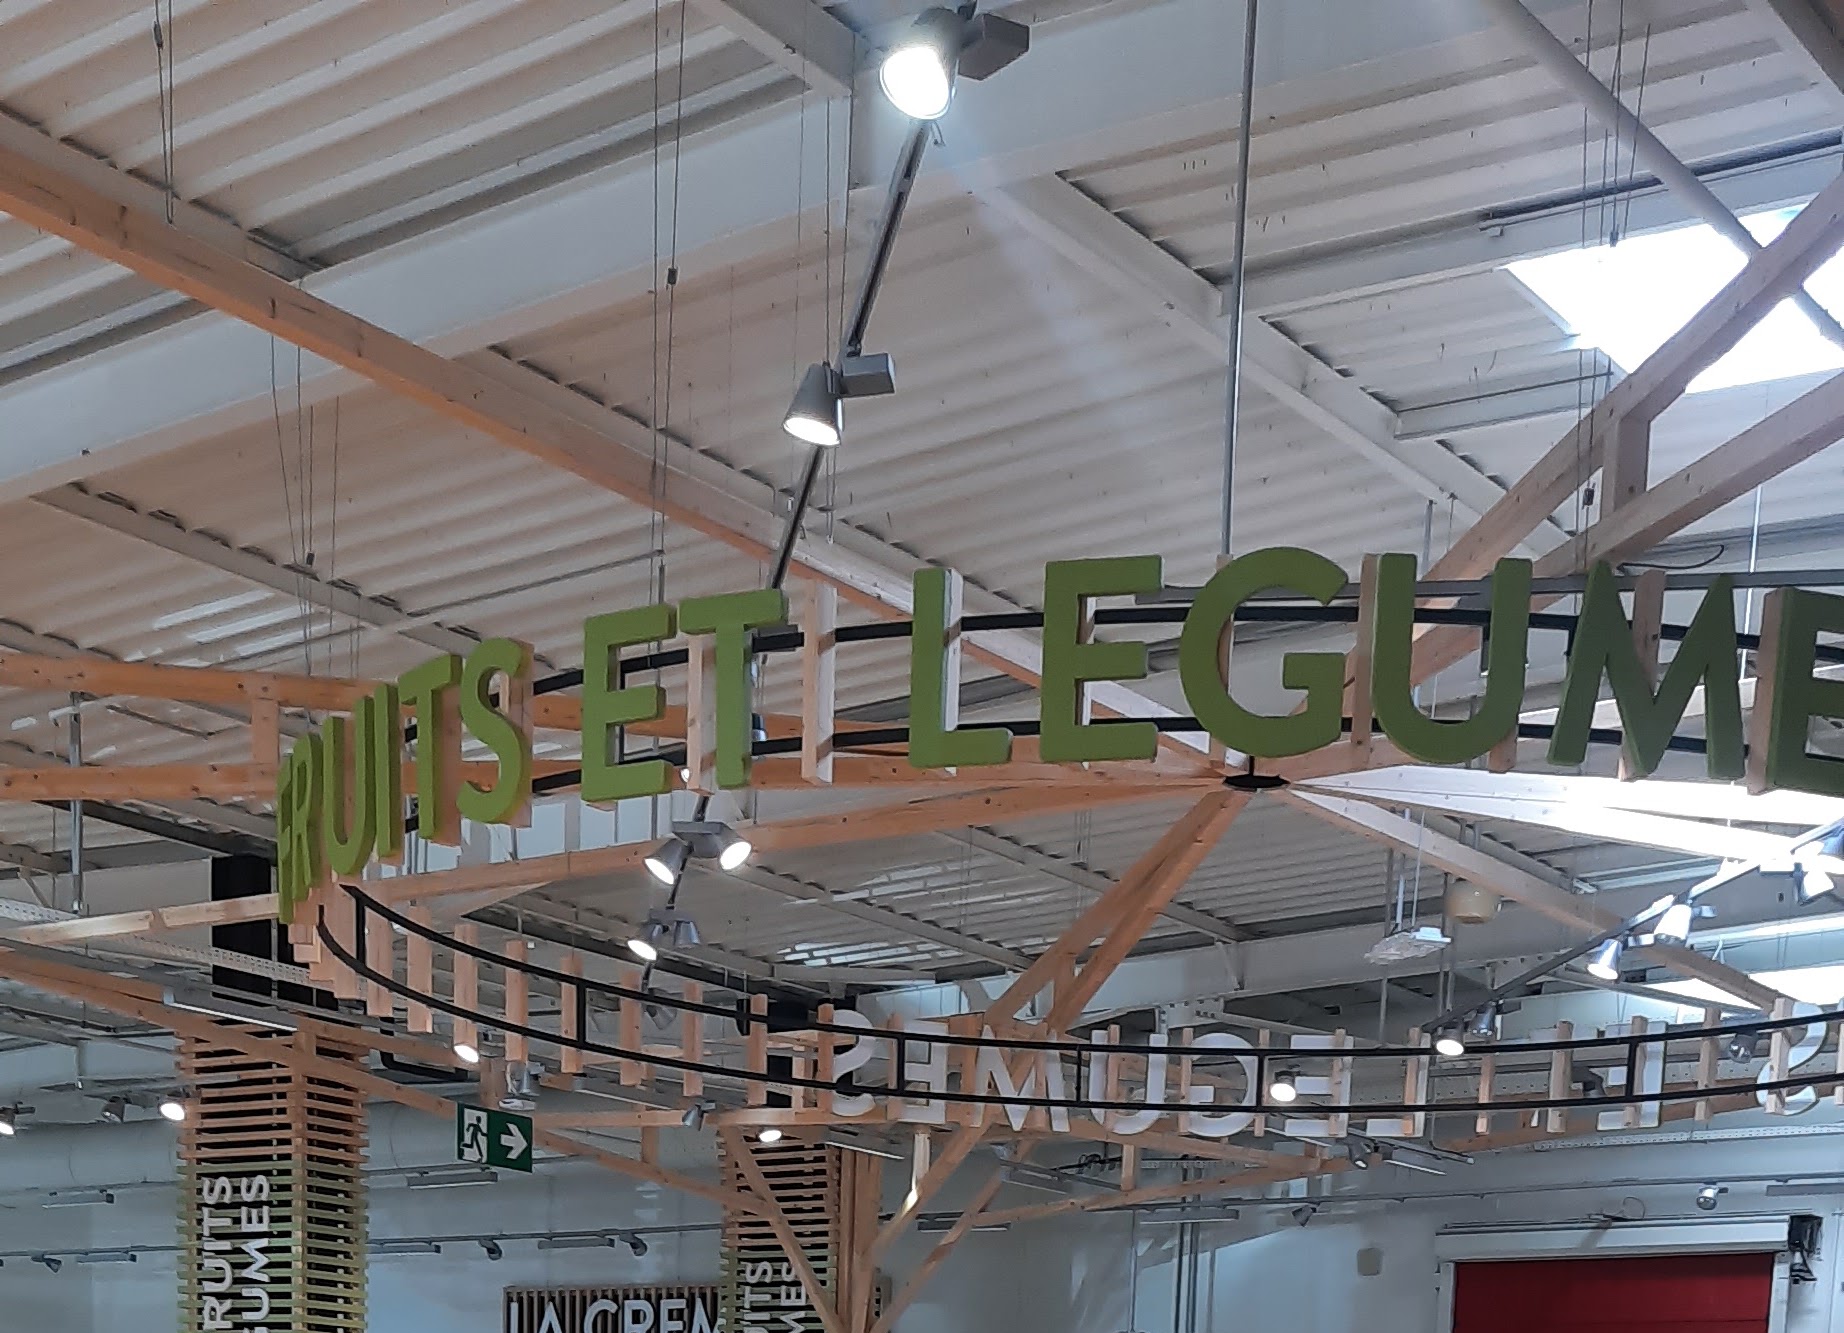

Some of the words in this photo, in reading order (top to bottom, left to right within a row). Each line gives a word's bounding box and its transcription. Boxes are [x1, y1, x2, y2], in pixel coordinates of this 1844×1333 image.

[277, 636, 531, 924] FRUITS
[581, 588, 789, 802] ET
[908, 547, 1844, 796] LEGUME
